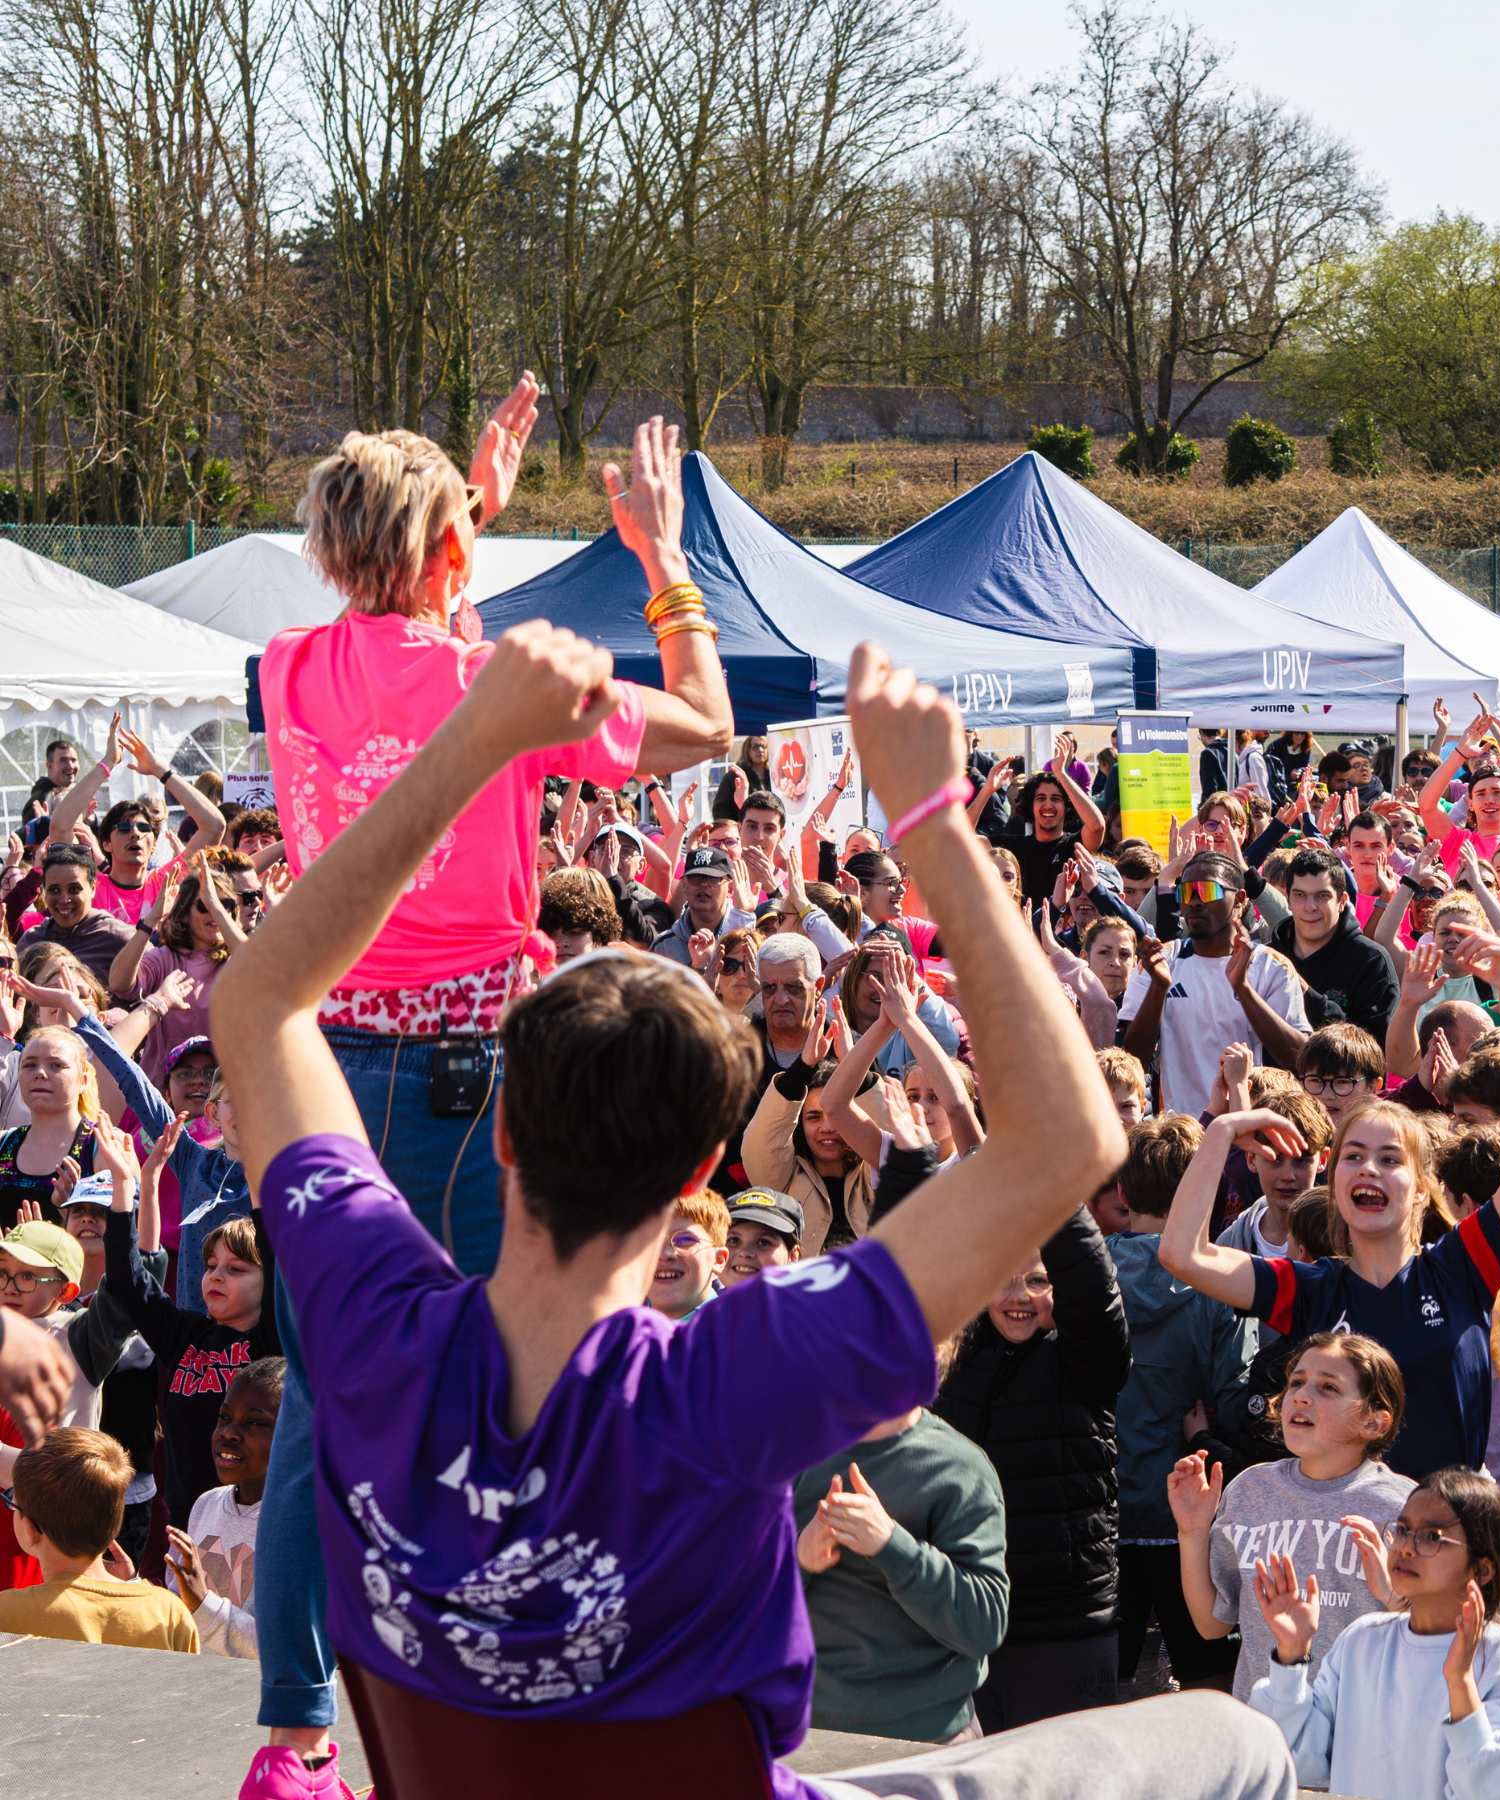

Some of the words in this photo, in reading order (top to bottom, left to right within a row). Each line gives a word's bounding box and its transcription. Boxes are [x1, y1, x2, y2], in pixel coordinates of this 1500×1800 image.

[1262, 650, 1312, 690] UPJV
[952, 673, 1013, 713] UPJV
[1250, 703, 1295, 713] Somme
[227, 774, 247, 782] Plus
[1312, 1519, 1367, 1580] YO
